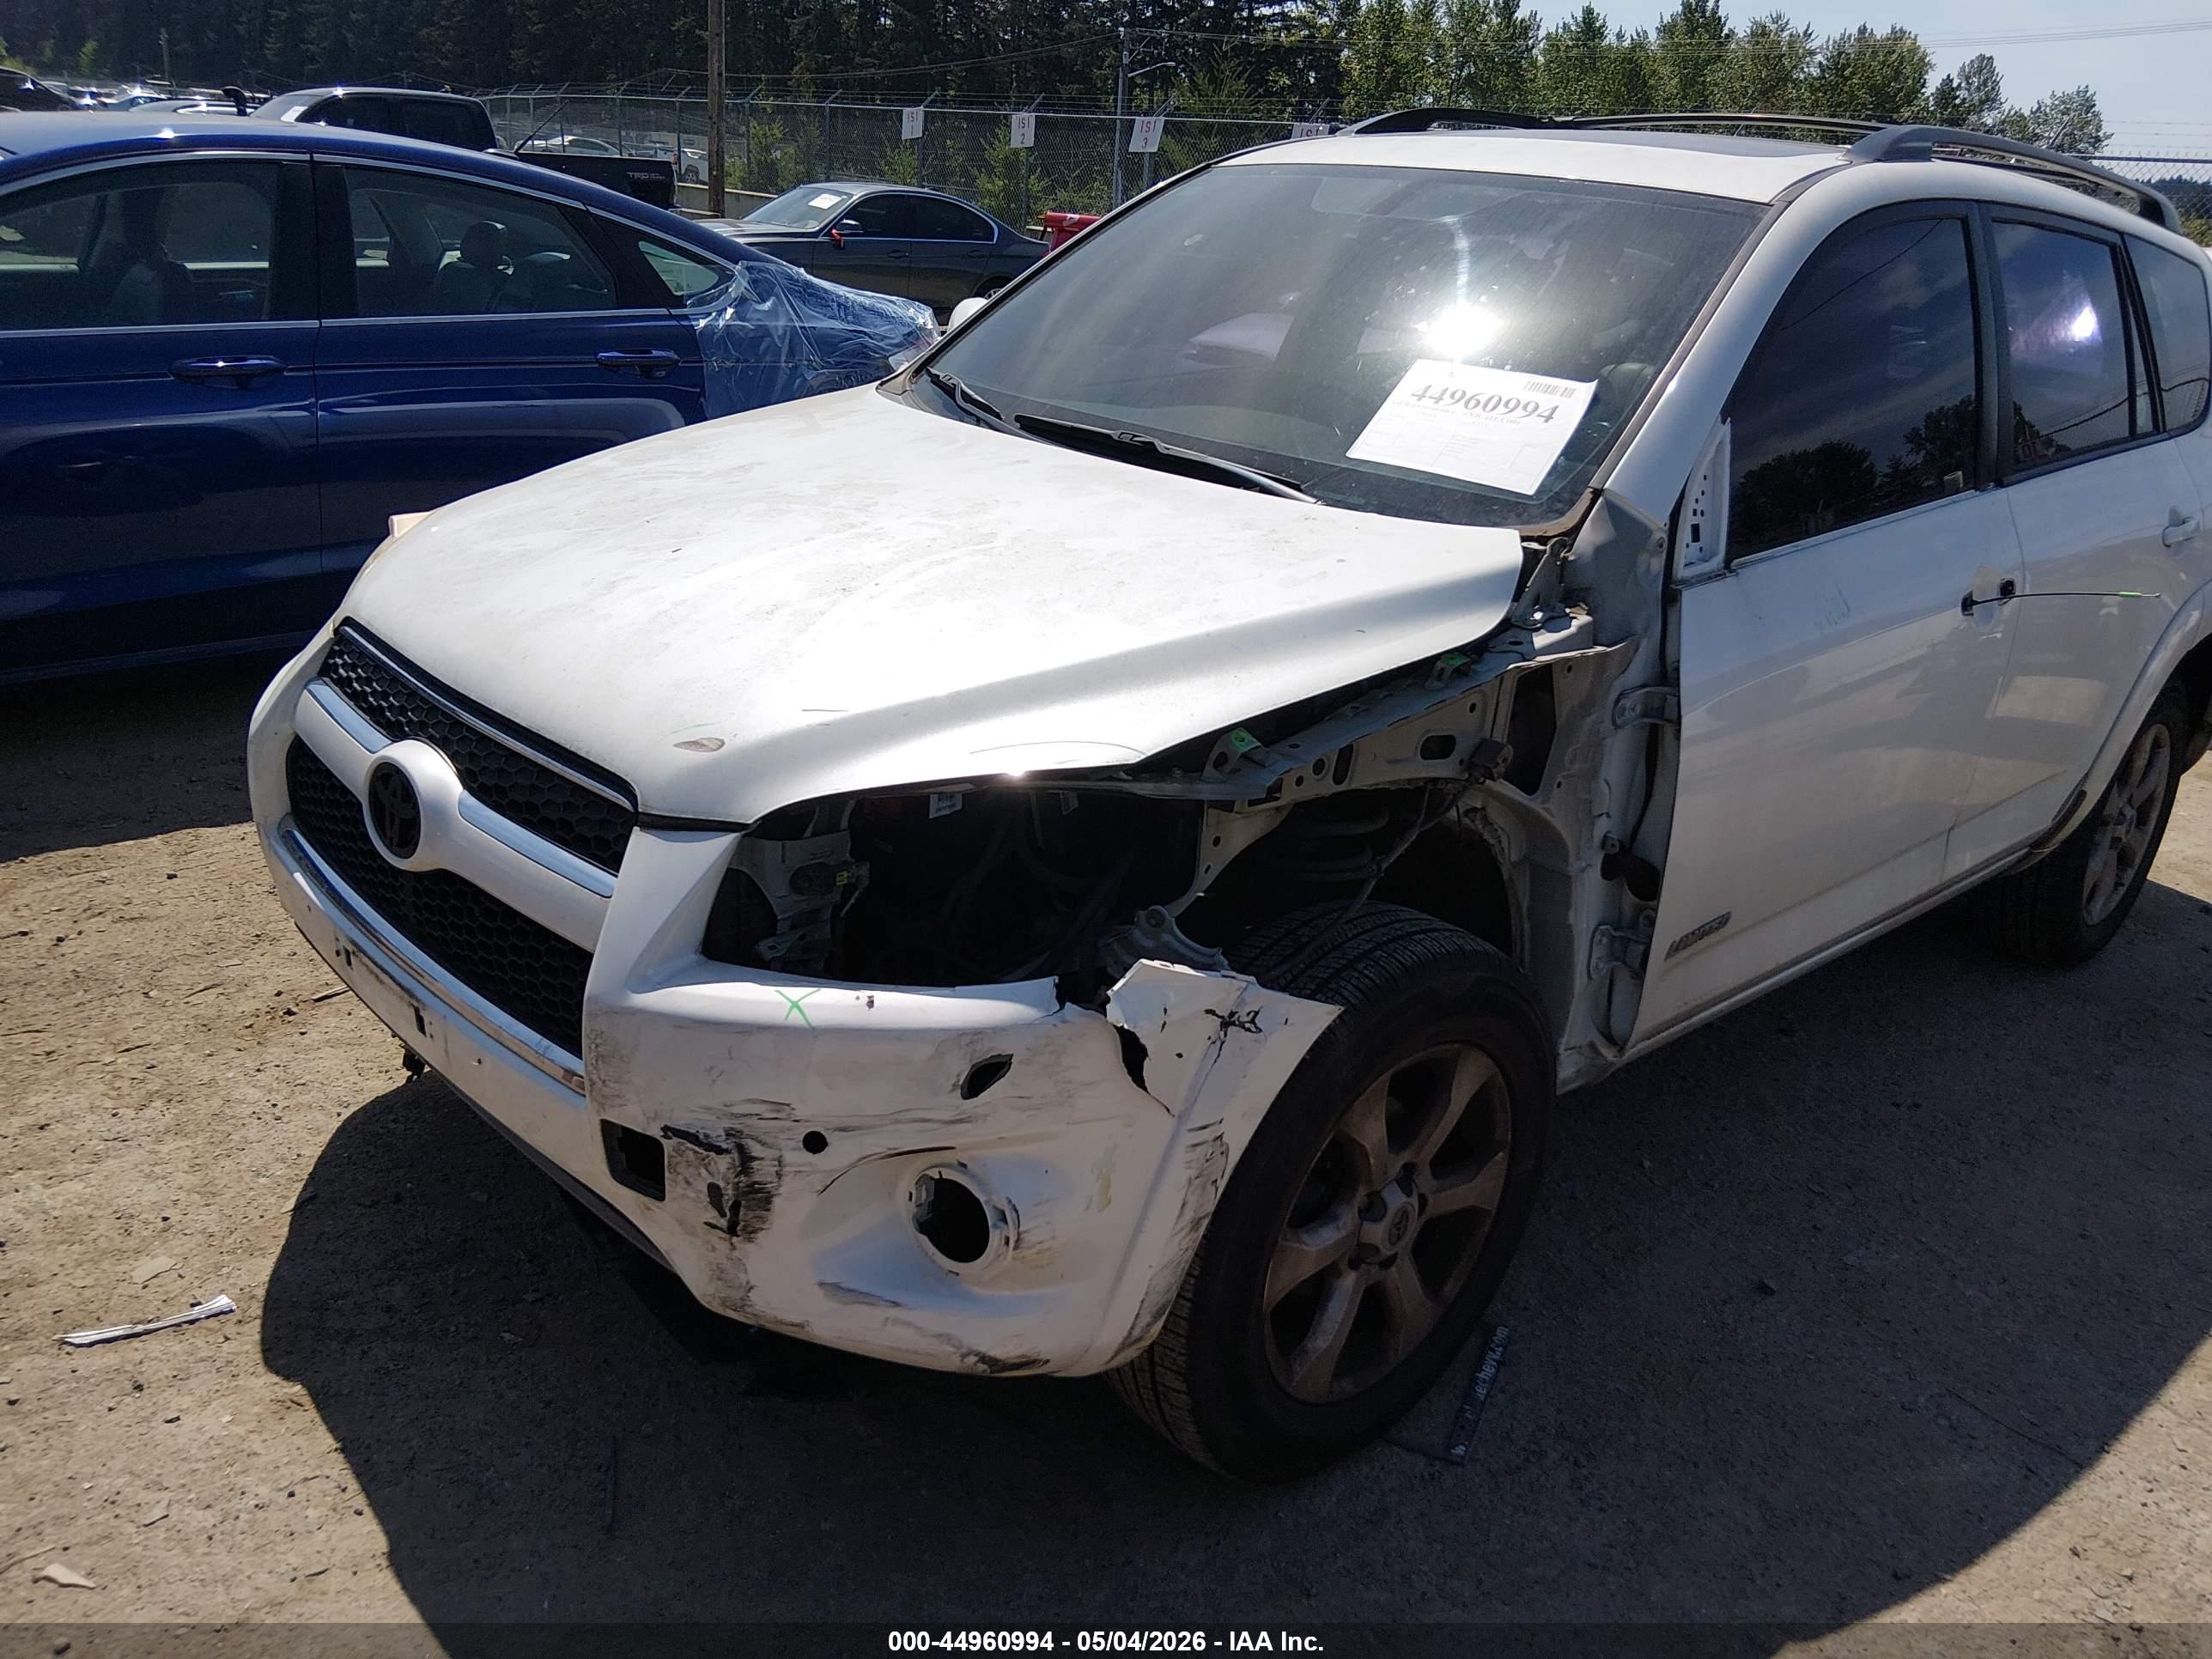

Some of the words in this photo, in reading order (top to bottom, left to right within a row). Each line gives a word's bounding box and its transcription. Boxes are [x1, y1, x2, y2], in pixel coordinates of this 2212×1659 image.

[1020, 132, 1025, 145] 2
[1141, 137, 1148, 149] 3
[626, 171, 650, 179] TRD
[1410, 384, 1560, 424] 44960994
